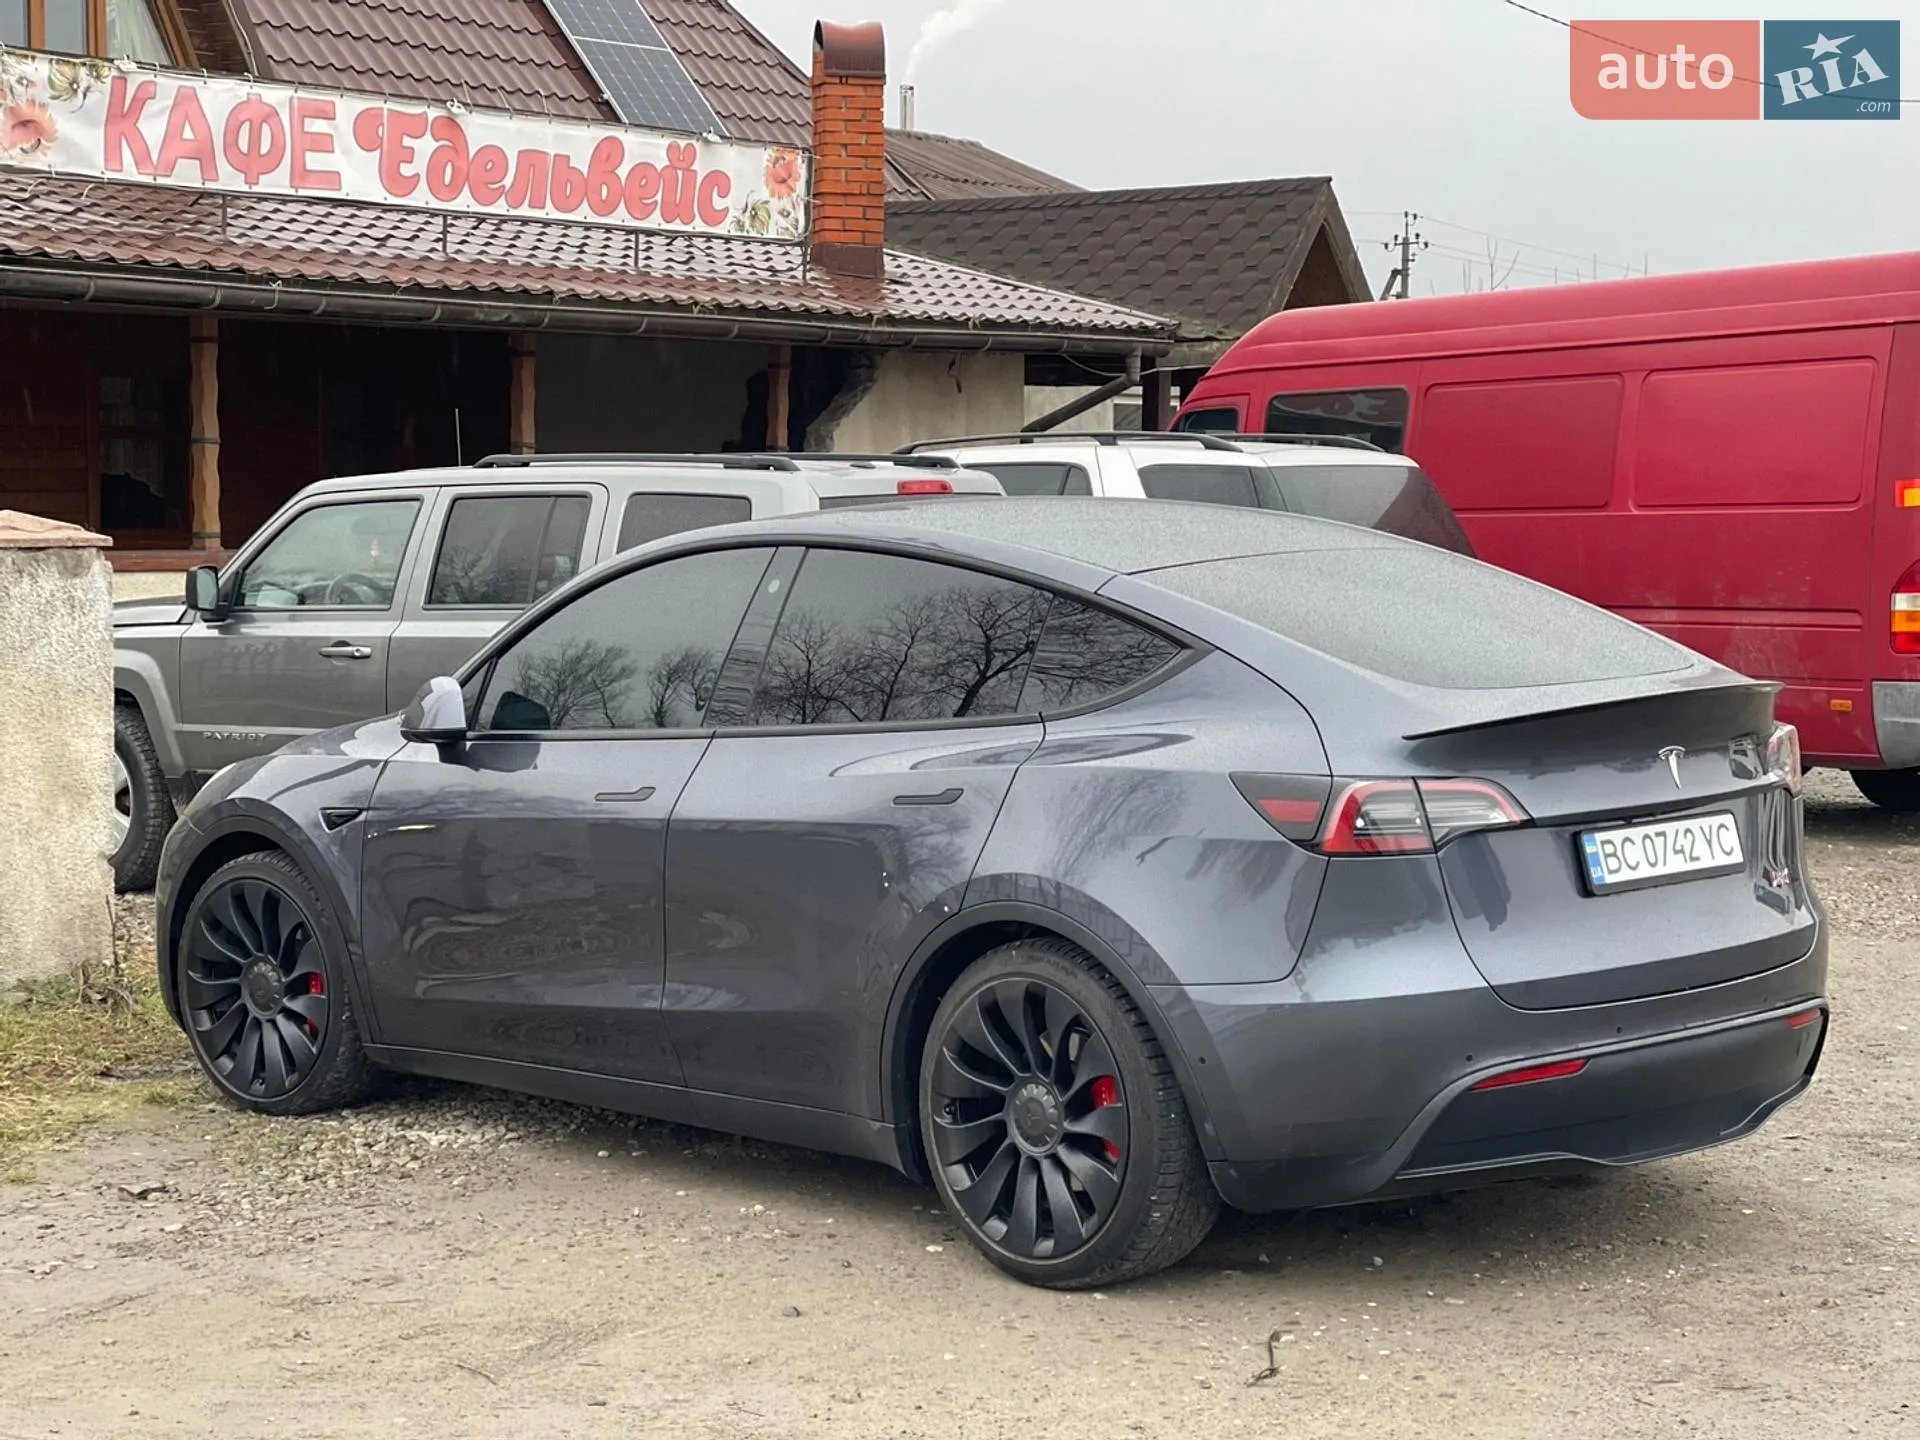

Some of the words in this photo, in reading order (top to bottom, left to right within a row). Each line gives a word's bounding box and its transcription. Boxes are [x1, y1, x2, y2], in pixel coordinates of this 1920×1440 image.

[104, 76, 342, 191] КАФЕ
[353, 106, 731, 227] Едельвейс
[202, 731, 268, 741] PATRIOT
